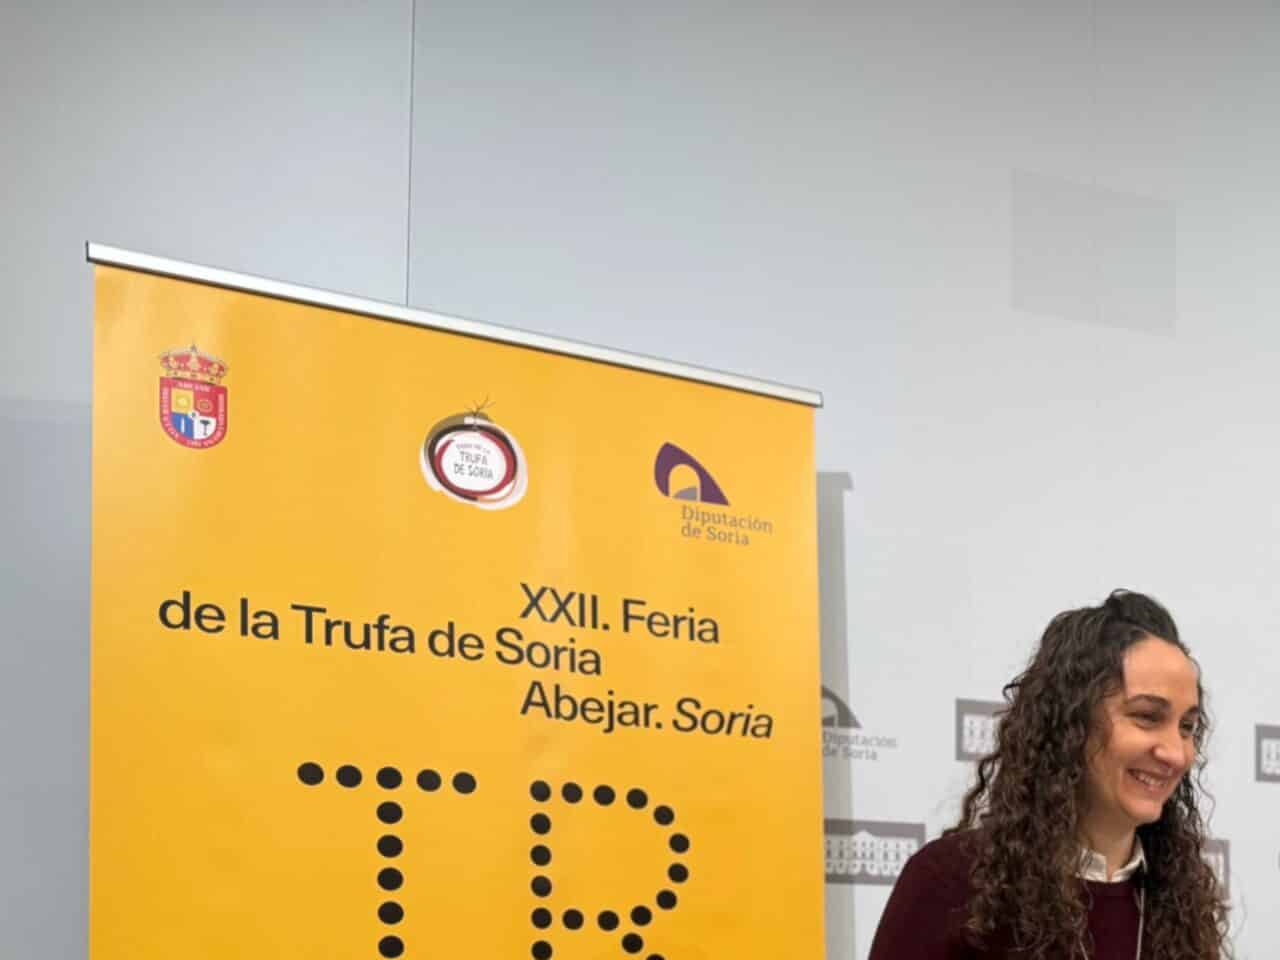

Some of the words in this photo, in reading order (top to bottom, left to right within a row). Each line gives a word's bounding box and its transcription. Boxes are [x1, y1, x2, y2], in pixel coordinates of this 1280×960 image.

[681, 504, 774, 534] Diputación
[681, 521, 702, 540] de
[706, 526, 750, 546] Soria
[158, 589, 226, 634] de
[239, 597, 280, 641] la
[290, 603, 416, 654] Trufa
[428, 621, 485, 661] de
[495, 626, 602, 676] Soria
[519, 582, 611, 631] XXII.
[622, 598, 720, 644] Feria
[519, 680, 663, 734] Abejar.
[671, 697, 774, 738] Soria
